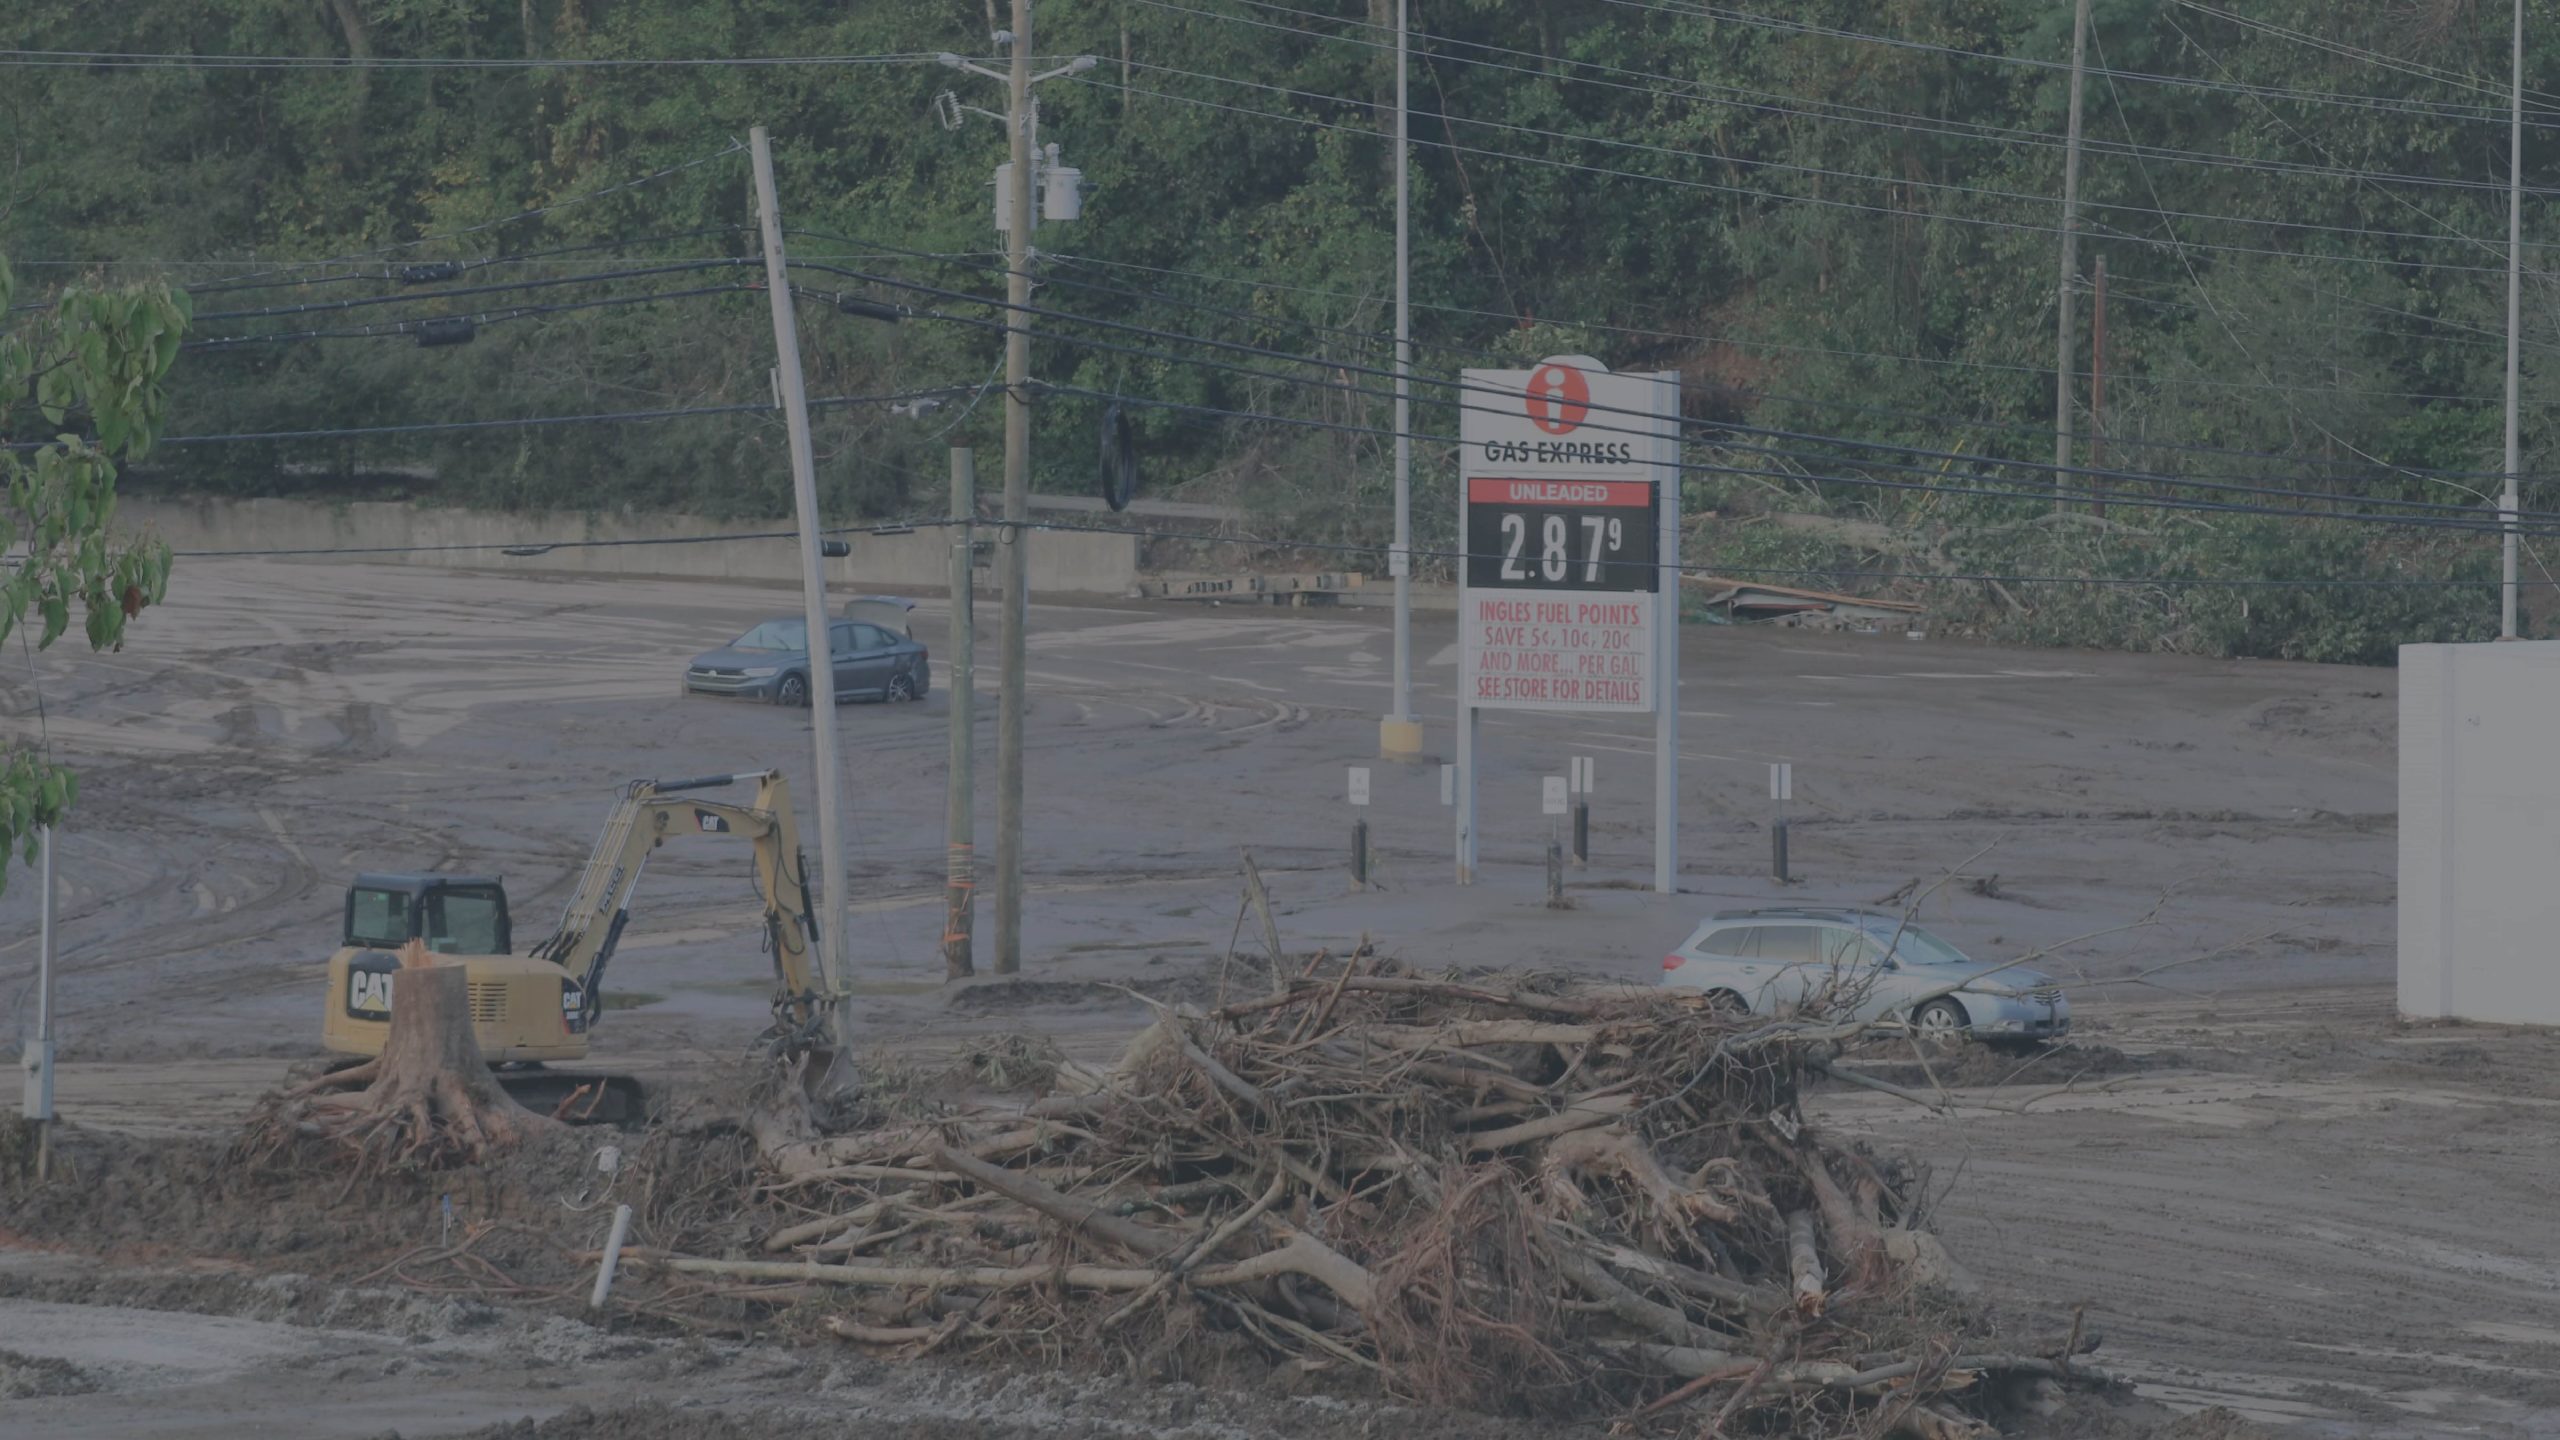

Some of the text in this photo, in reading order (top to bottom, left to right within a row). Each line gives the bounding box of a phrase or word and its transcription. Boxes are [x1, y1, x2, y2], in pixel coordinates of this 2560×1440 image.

[1485, 441, 1631, 464] GAS EXPRESS
[1510, 484, 1608, 501] UNLEADED
[1480, 601, 1639, 624] INGLES FUEL POINTS
[1485, 627, 1525, 646] SAVE
[1480, 652, 1511, 671] AND
[1579, 654, 1604, 674] PER
[1610, 655, 1638, 675] GAL
[1478, 677, 1639, 702] SEE STORE FOR DETAILS
[702, 816, 718, 831] CAT
[563, 991, 582, 1009] CAT
